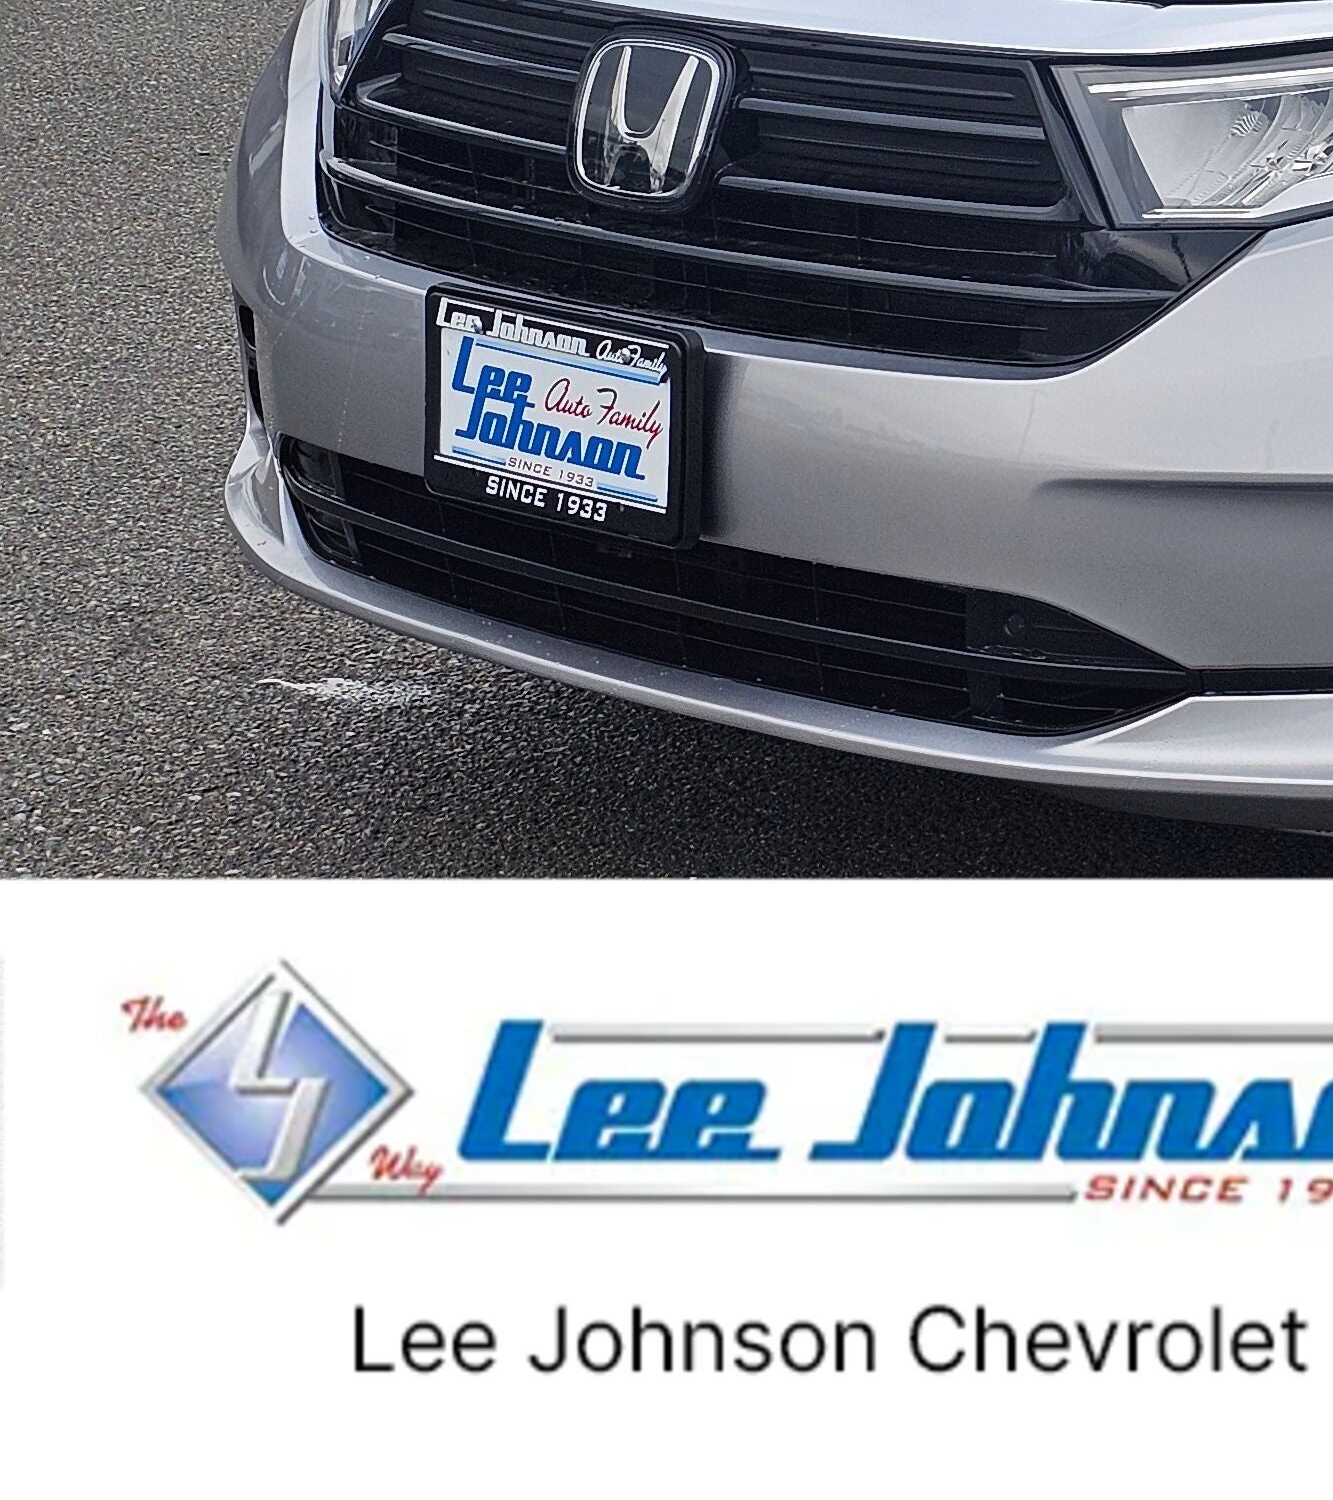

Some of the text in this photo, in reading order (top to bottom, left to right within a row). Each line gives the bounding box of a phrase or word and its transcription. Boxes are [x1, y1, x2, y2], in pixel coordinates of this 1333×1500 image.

[436, 296, 483, 333] Lee
[485, 309, 590, 358] Johnson
[596, 339, 630, 364] Aut
[451, 335, 536, 408] Lee
[455, 396, 646, 480] Johnson
[545, 378, 664, 450] Auto Family
[485, 475, 608, 522] SINCE 1933
[507, 456, 595, 488] SINCE 1933
